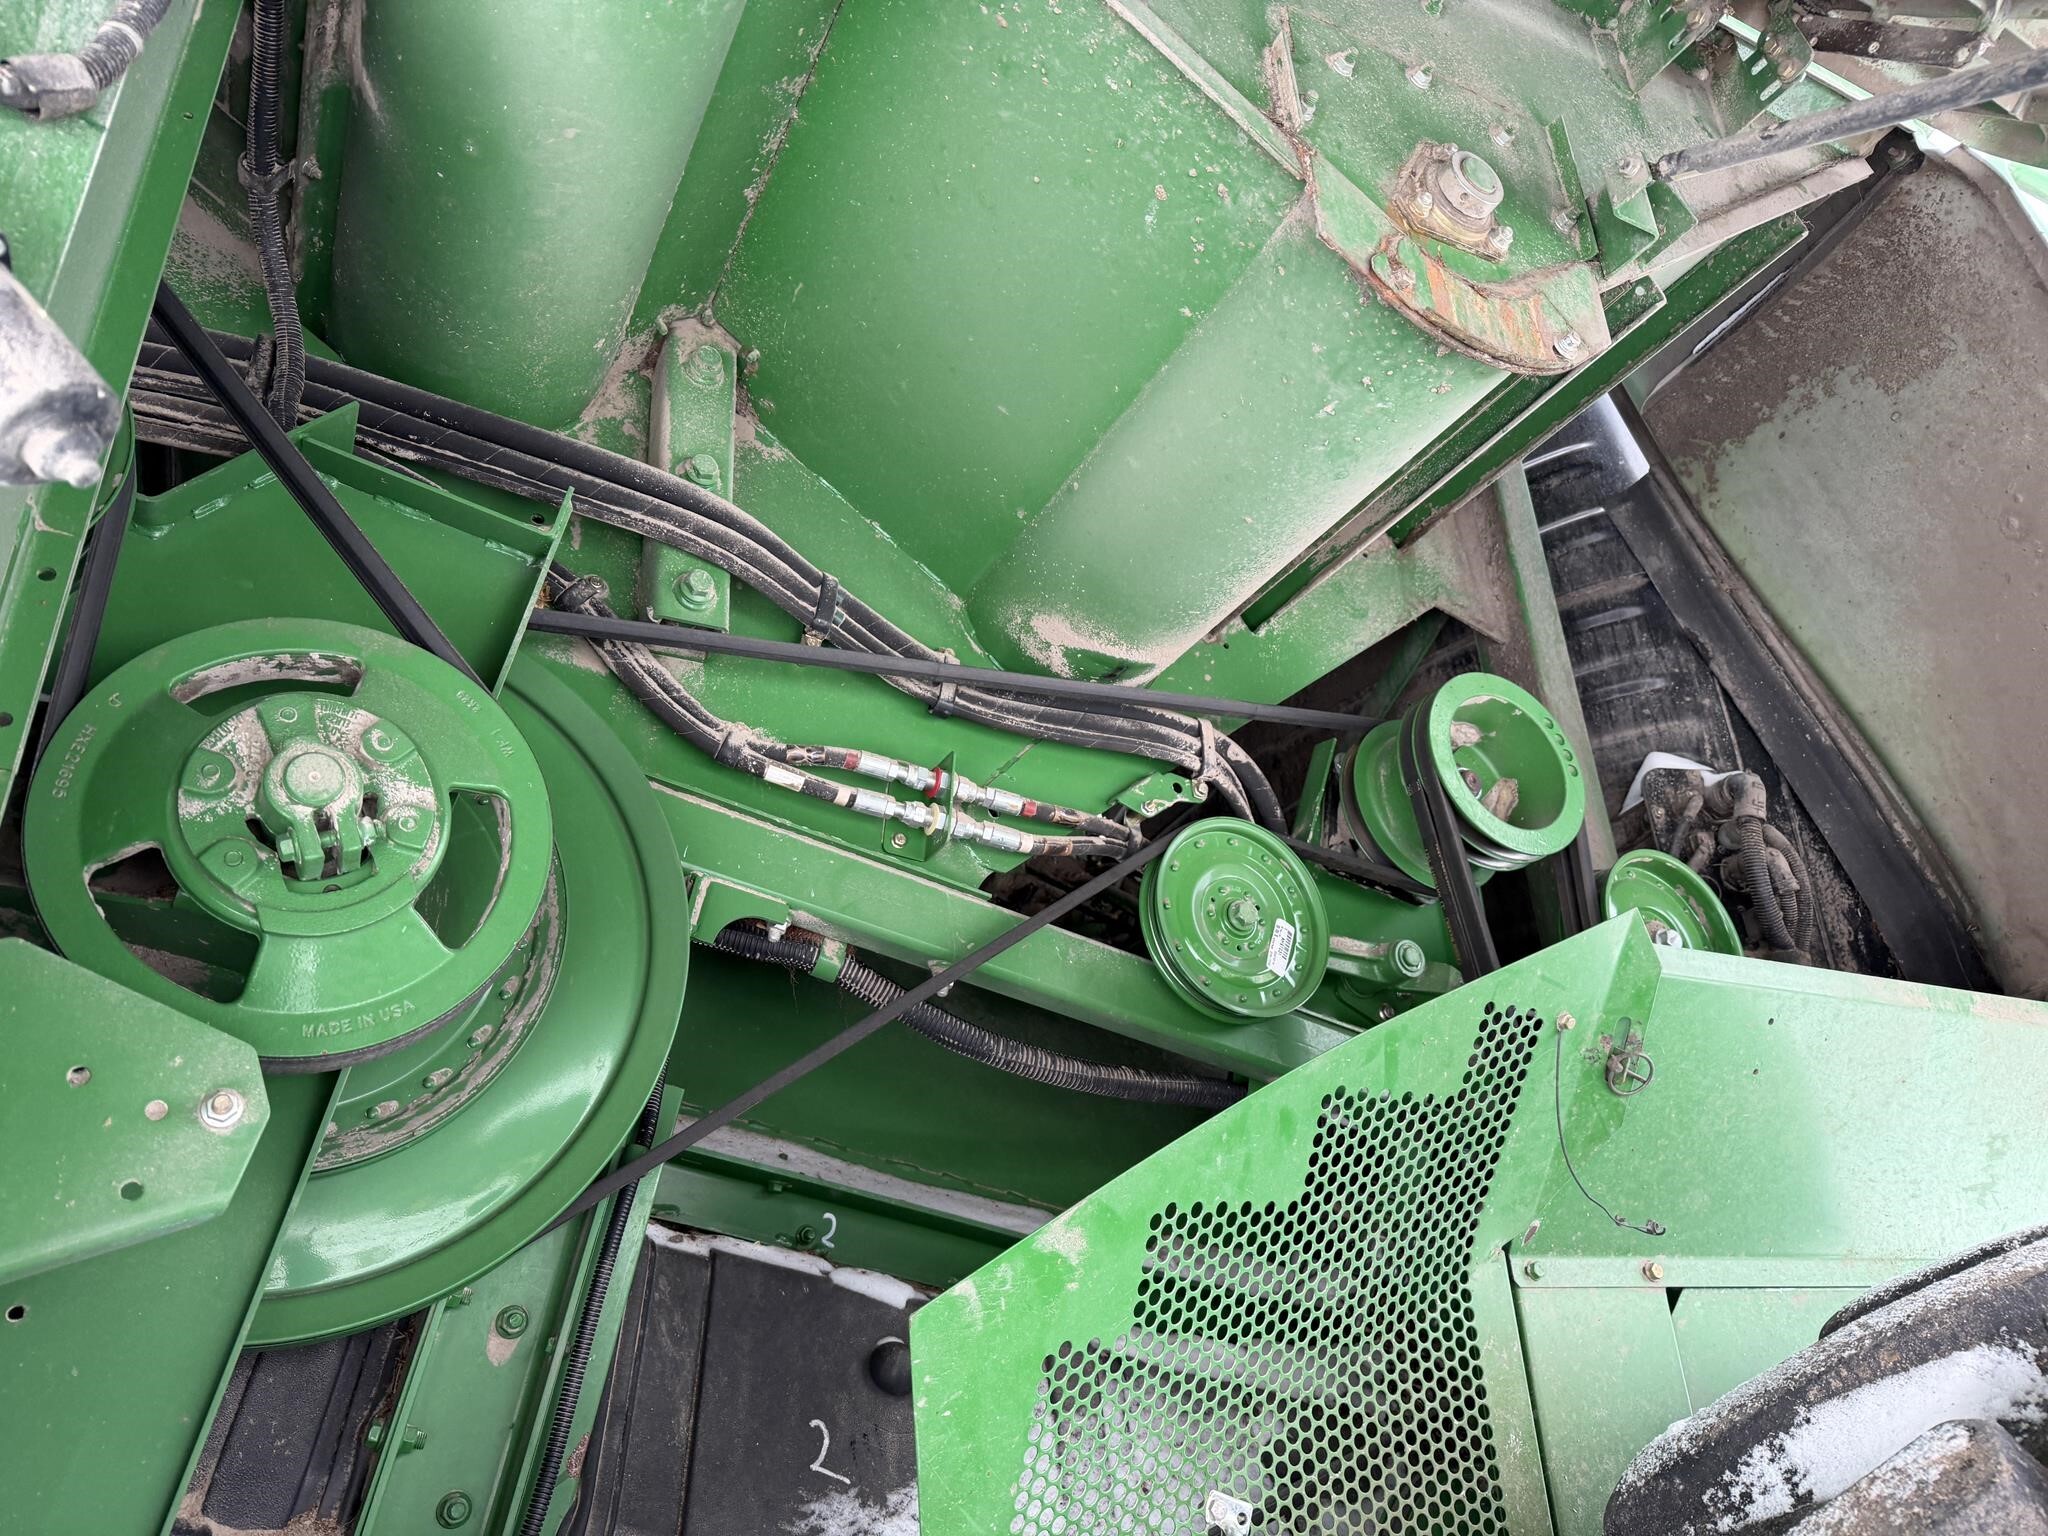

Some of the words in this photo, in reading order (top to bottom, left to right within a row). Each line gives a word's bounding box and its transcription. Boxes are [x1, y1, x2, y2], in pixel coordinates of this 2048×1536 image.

[301, 1018, 353, 1039] MADE
[357, 1012, 376, 1029] IN
[379, 999, 416, 1021] USA
[821, 1212, 837, 1249] 2
[809, 1418, 851, 1485] 2
